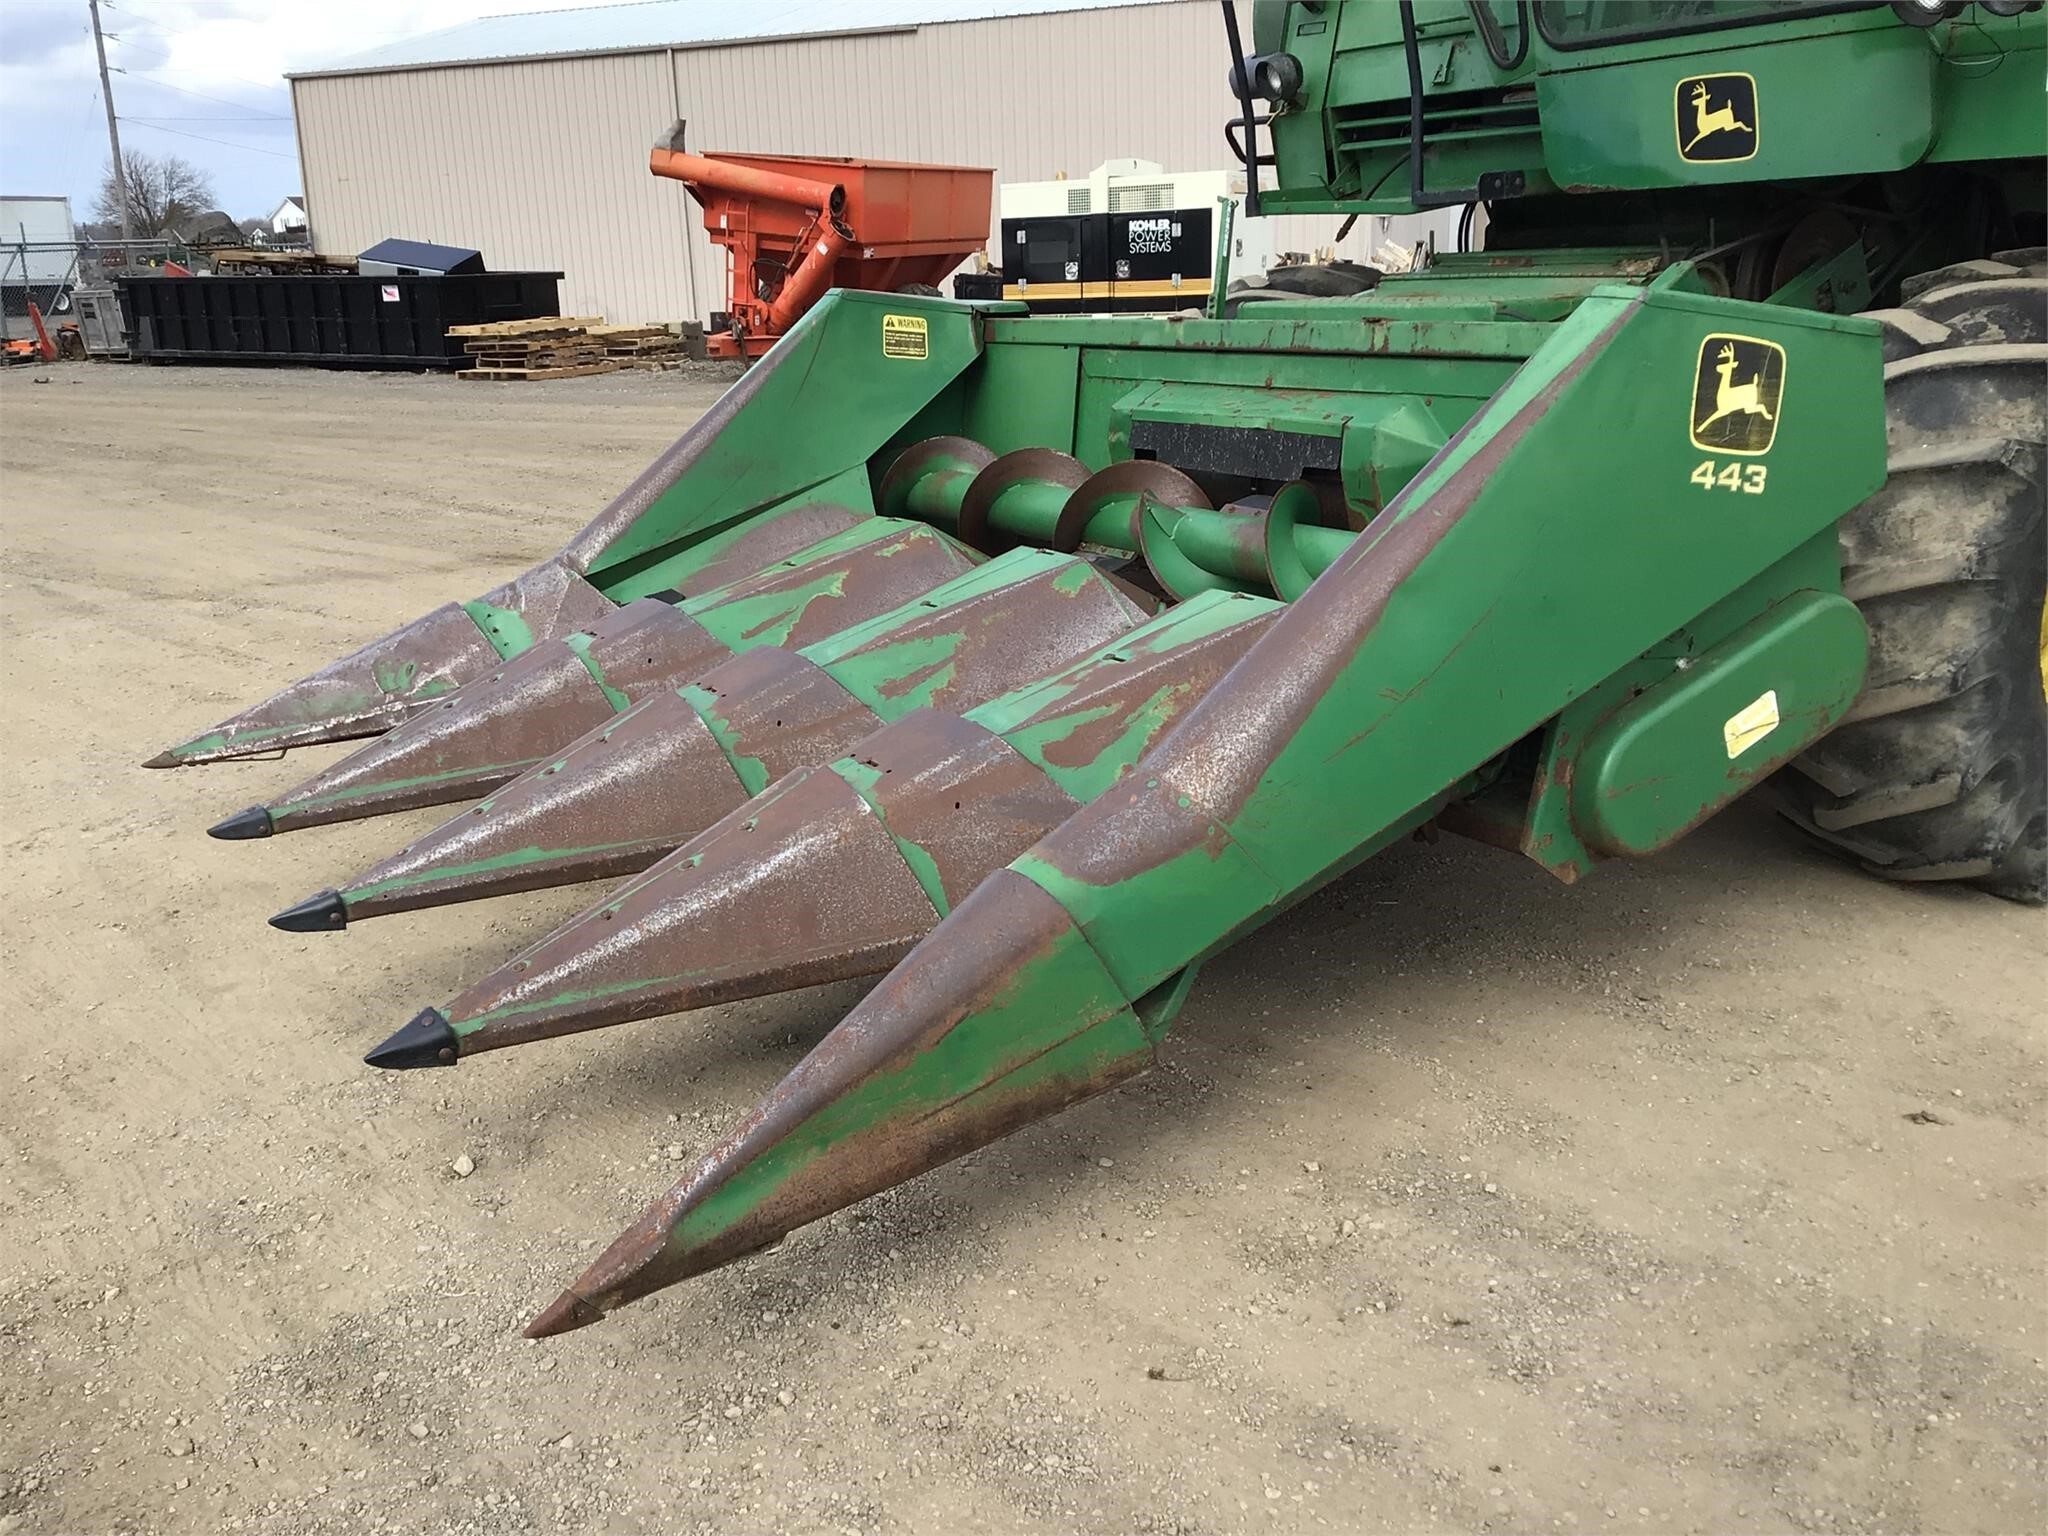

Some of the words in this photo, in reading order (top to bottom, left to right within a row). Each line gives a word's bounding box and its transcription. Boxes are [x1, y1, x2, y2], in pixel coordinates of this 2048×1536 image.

[1128, 219, 1171, 231] KOHLER
[1128, 230, 1171, 242] POWER
[1129, 241, 1172, 254] SYSTEMS
[897, 318, 925, 330] WARNING
[1690, 460, 1768, 494] 443
